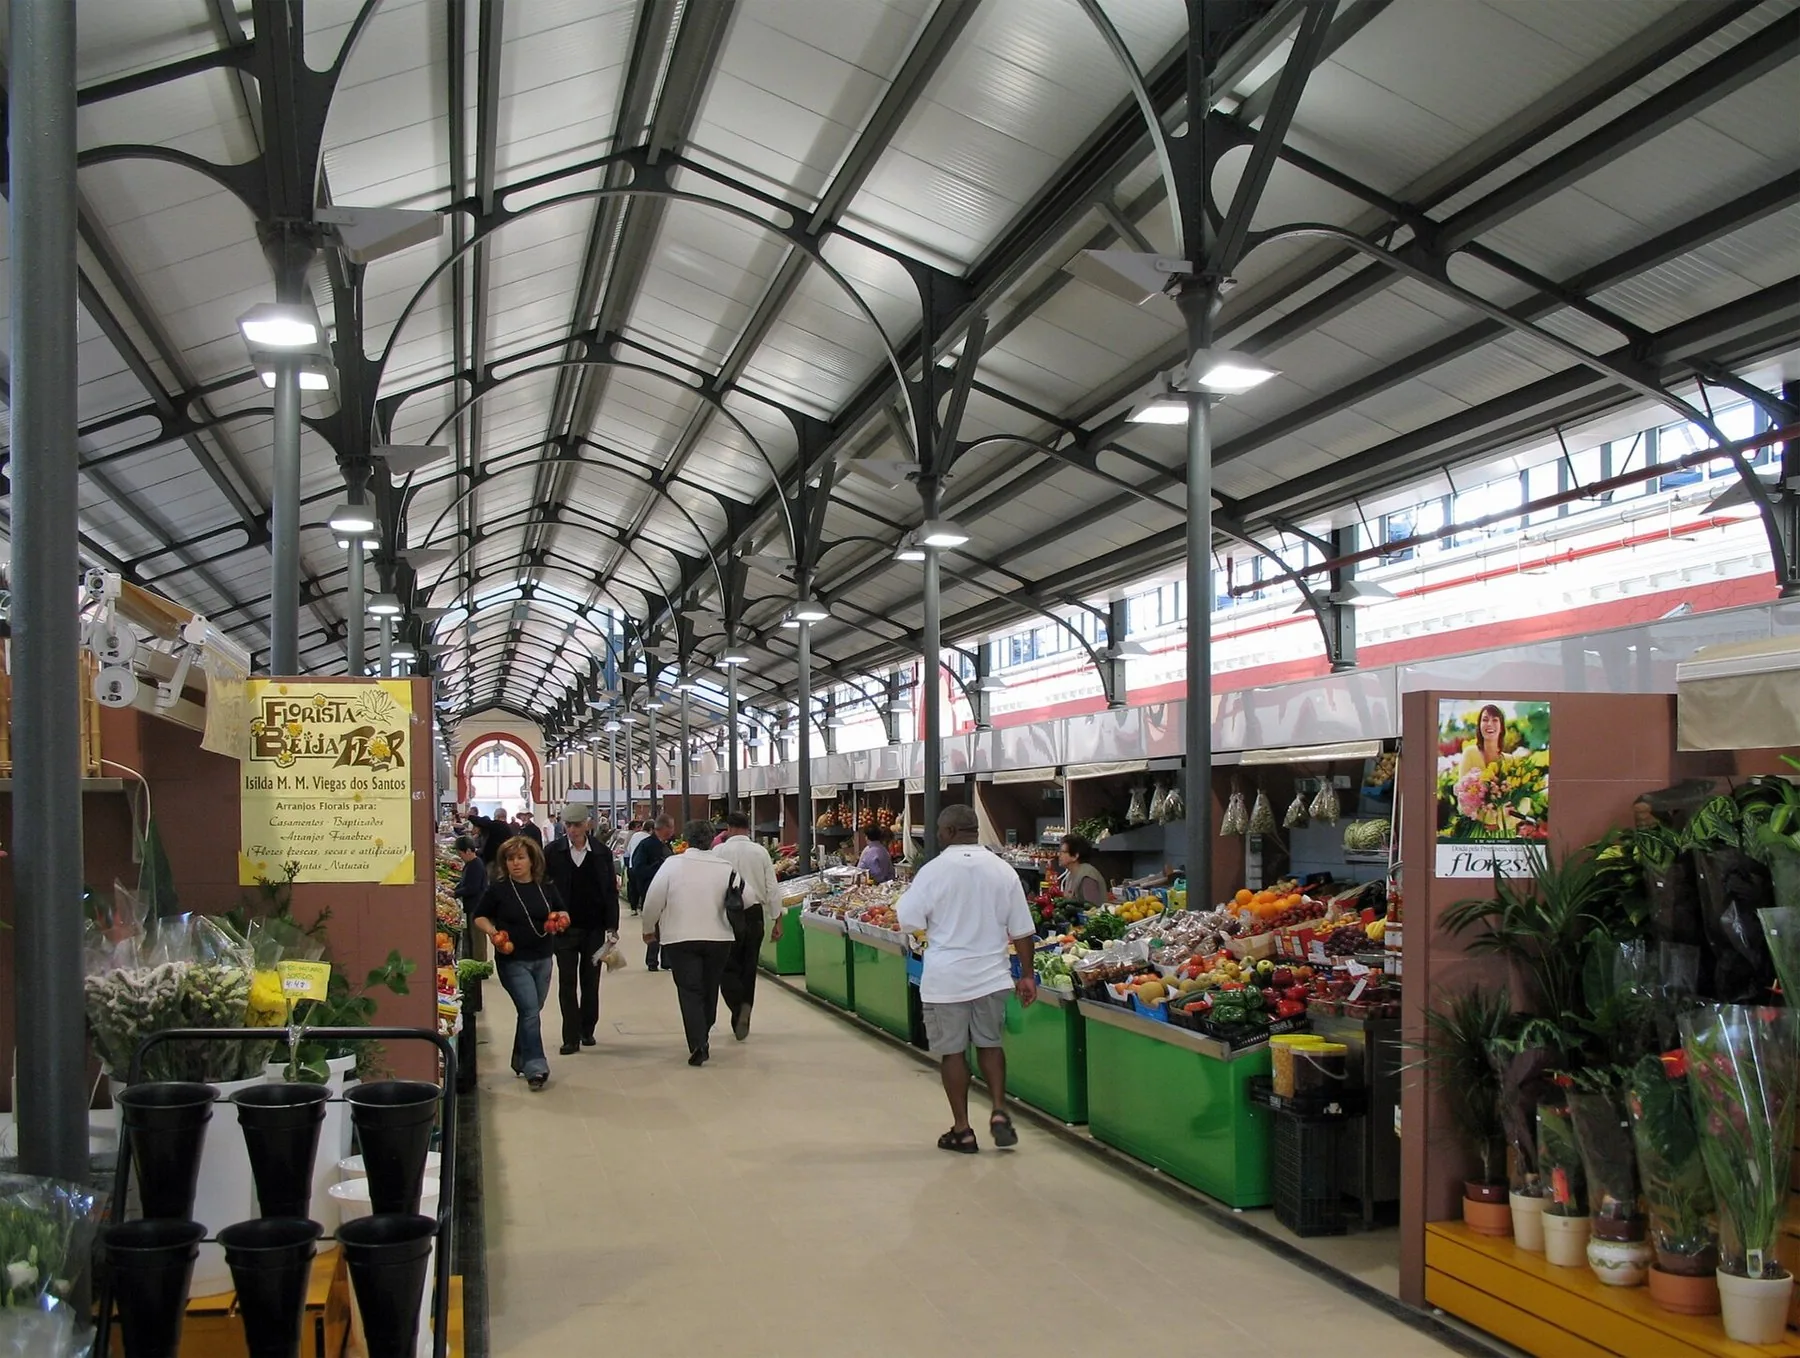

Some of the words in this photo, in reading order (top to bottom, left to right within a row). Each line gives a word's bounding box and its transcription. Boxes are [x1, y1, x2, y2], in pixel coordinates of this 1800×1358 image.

[245, 775, 273, 790] Isilda
[277, 775, 291, 790] M.
[295, 775, 309, 790] M.
[313, 775, 347, 792] Viegas
[350, 776, 368, 790] dos
[372, 776, 406, 790] Santos
[275, 802, 316, 812] Arranjos
[319, 802, 350, 811] Florais
[353, 803, 377, 812] para:
[269, 815, 324, 827] Casamentos
[333, 815, 384, 828] Baptizados
[280, 831, 325, 843] Arranjos
[324, 848, 347, 856] secas
[358, 845, 407, 858] artificiais)
[325, 859, 370, 871] Naturais
